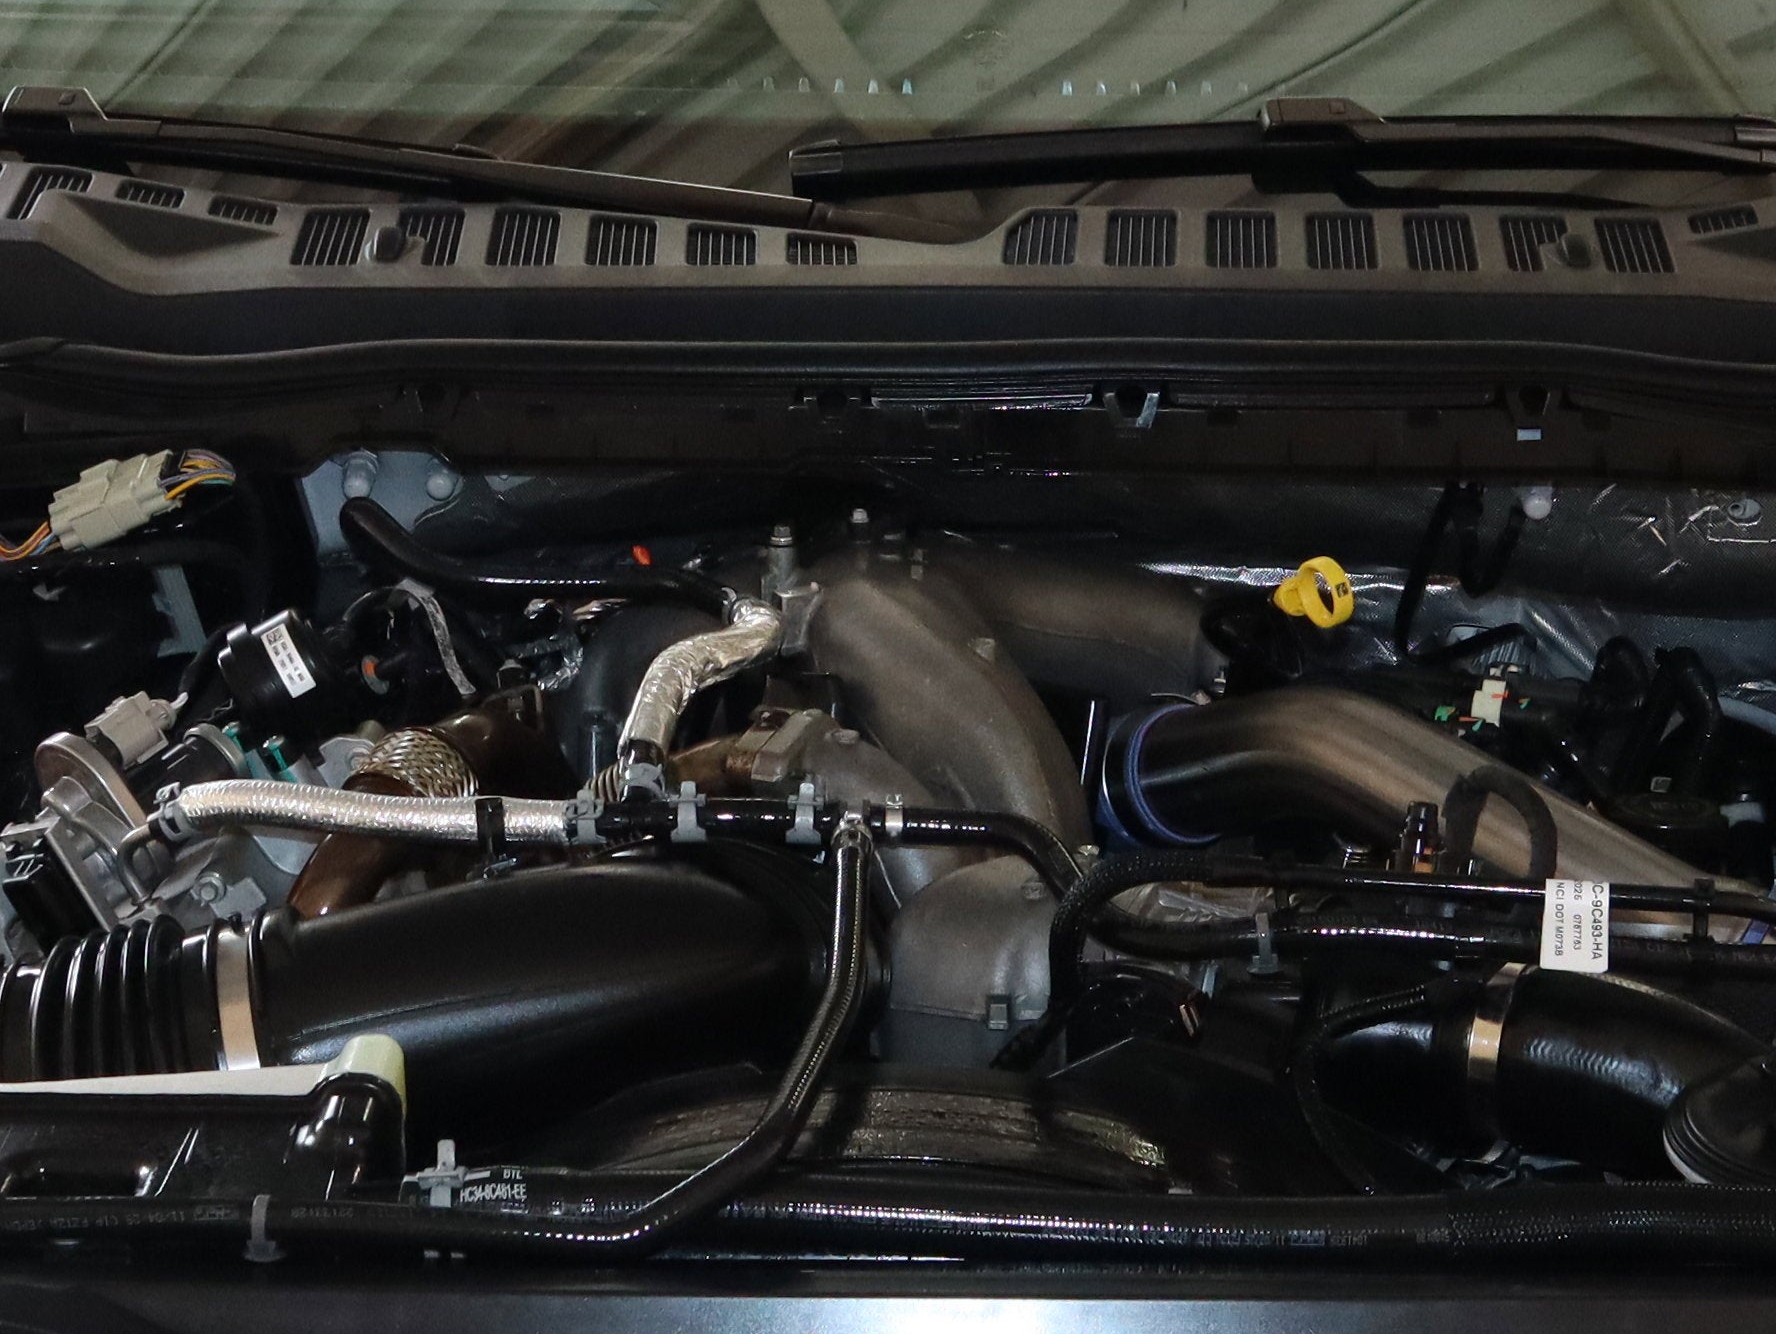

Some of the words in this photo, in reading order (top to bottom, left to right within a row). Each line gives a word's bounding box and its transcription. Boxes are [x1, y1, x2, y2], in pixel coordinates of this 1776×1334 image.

[1556, 883, 1565, 900] NCI
[1555, 904, 1564, 923] DOT
[1592, 881, 1604, 960] C-9C493-HA
